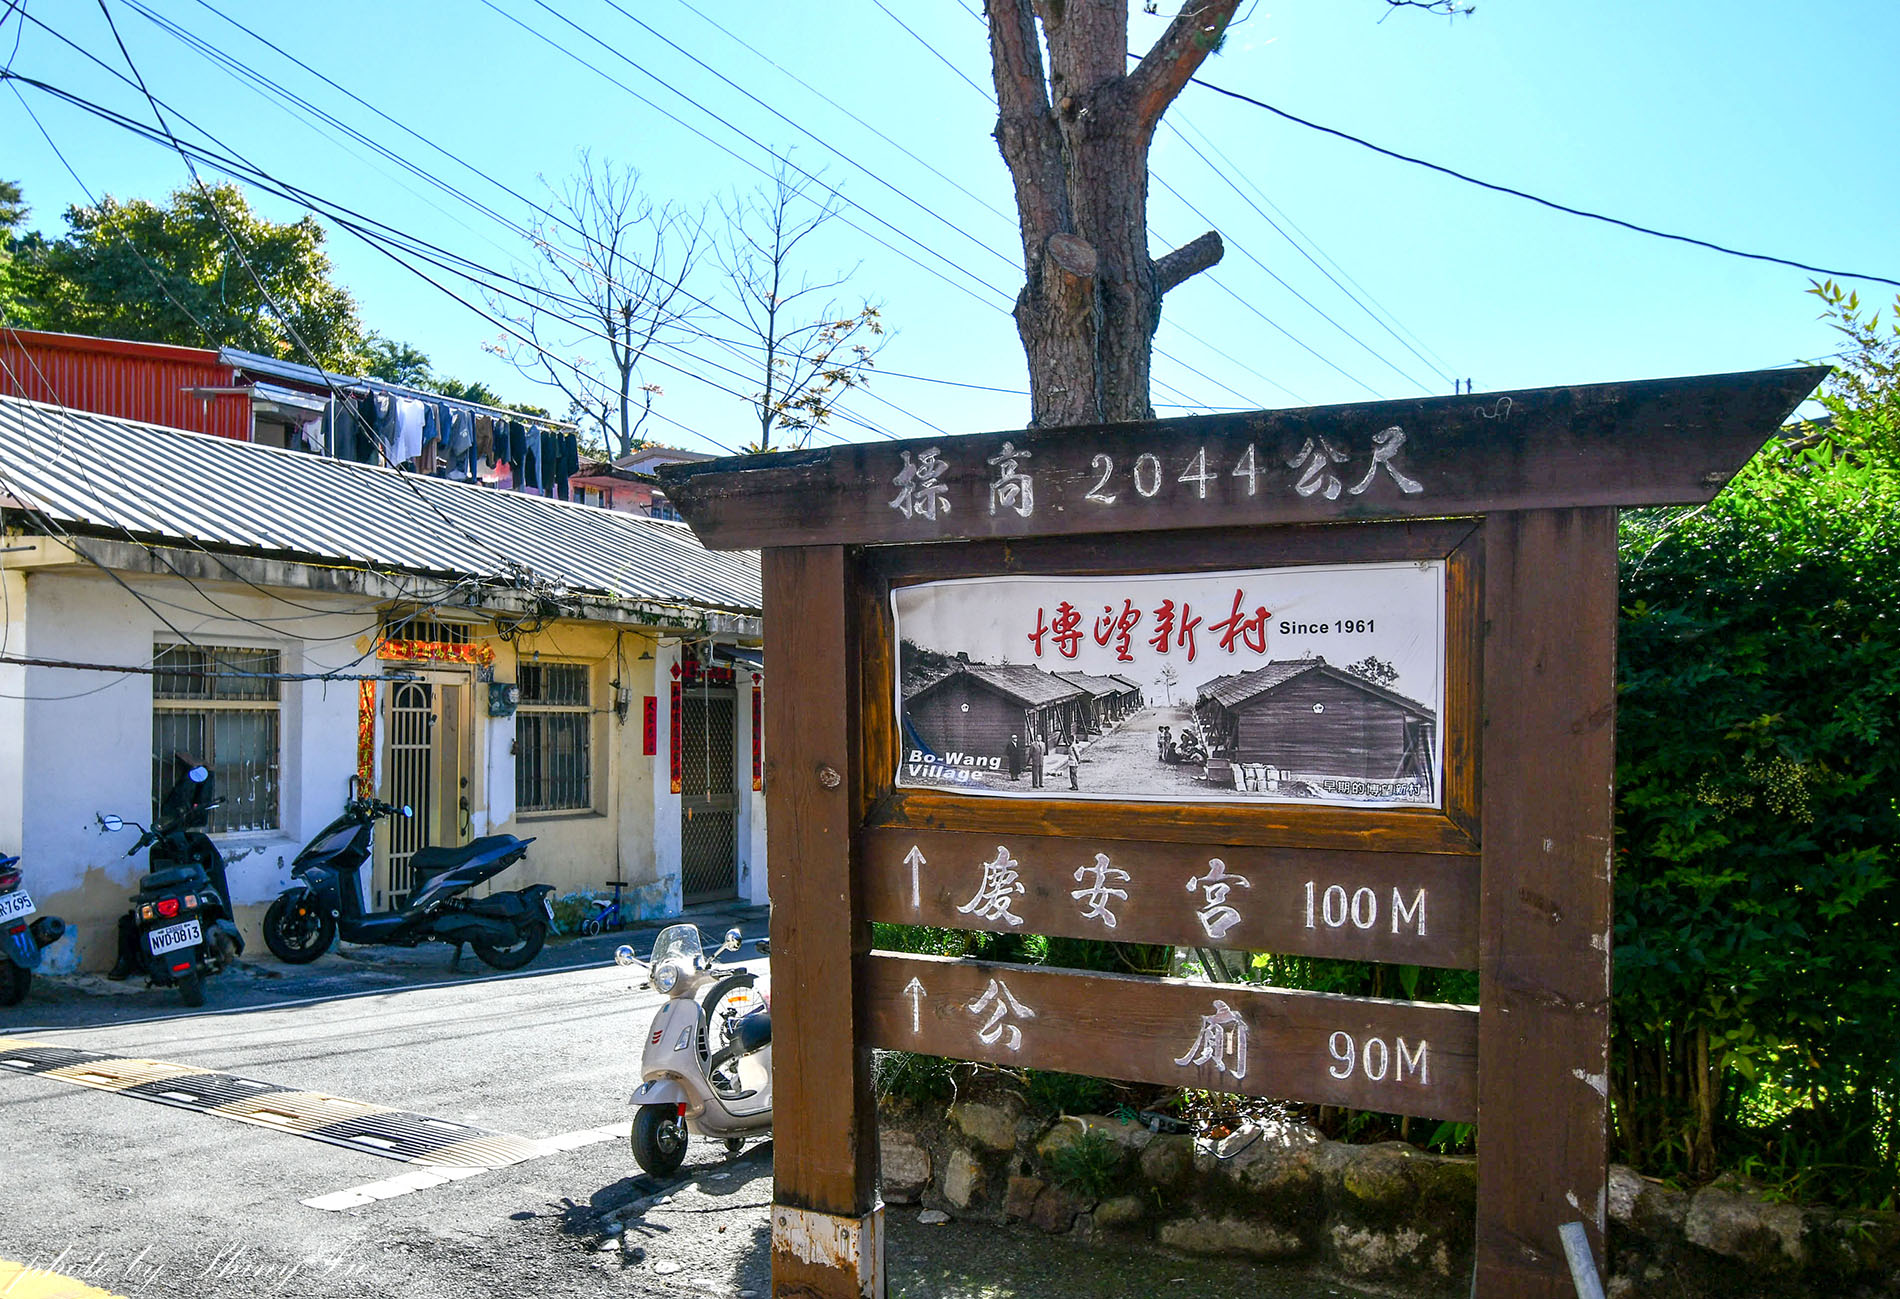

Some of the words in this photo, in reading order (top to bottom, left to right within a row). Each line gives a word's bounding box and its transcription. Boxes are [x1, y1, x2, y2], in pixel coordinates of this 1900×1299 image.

[1084, 443, 1266, 504] 2044
[1027, 588, 1273, 663] 博望新村
[1279, 619, 1329, 635] Since
[1334, 619, 1376, 634] 1961
[908, 750, 1002, 770] Bo-Wang
[908, 764, 983, 783] Village
[1323, 779, 1422, 797] 早期的博望新村
